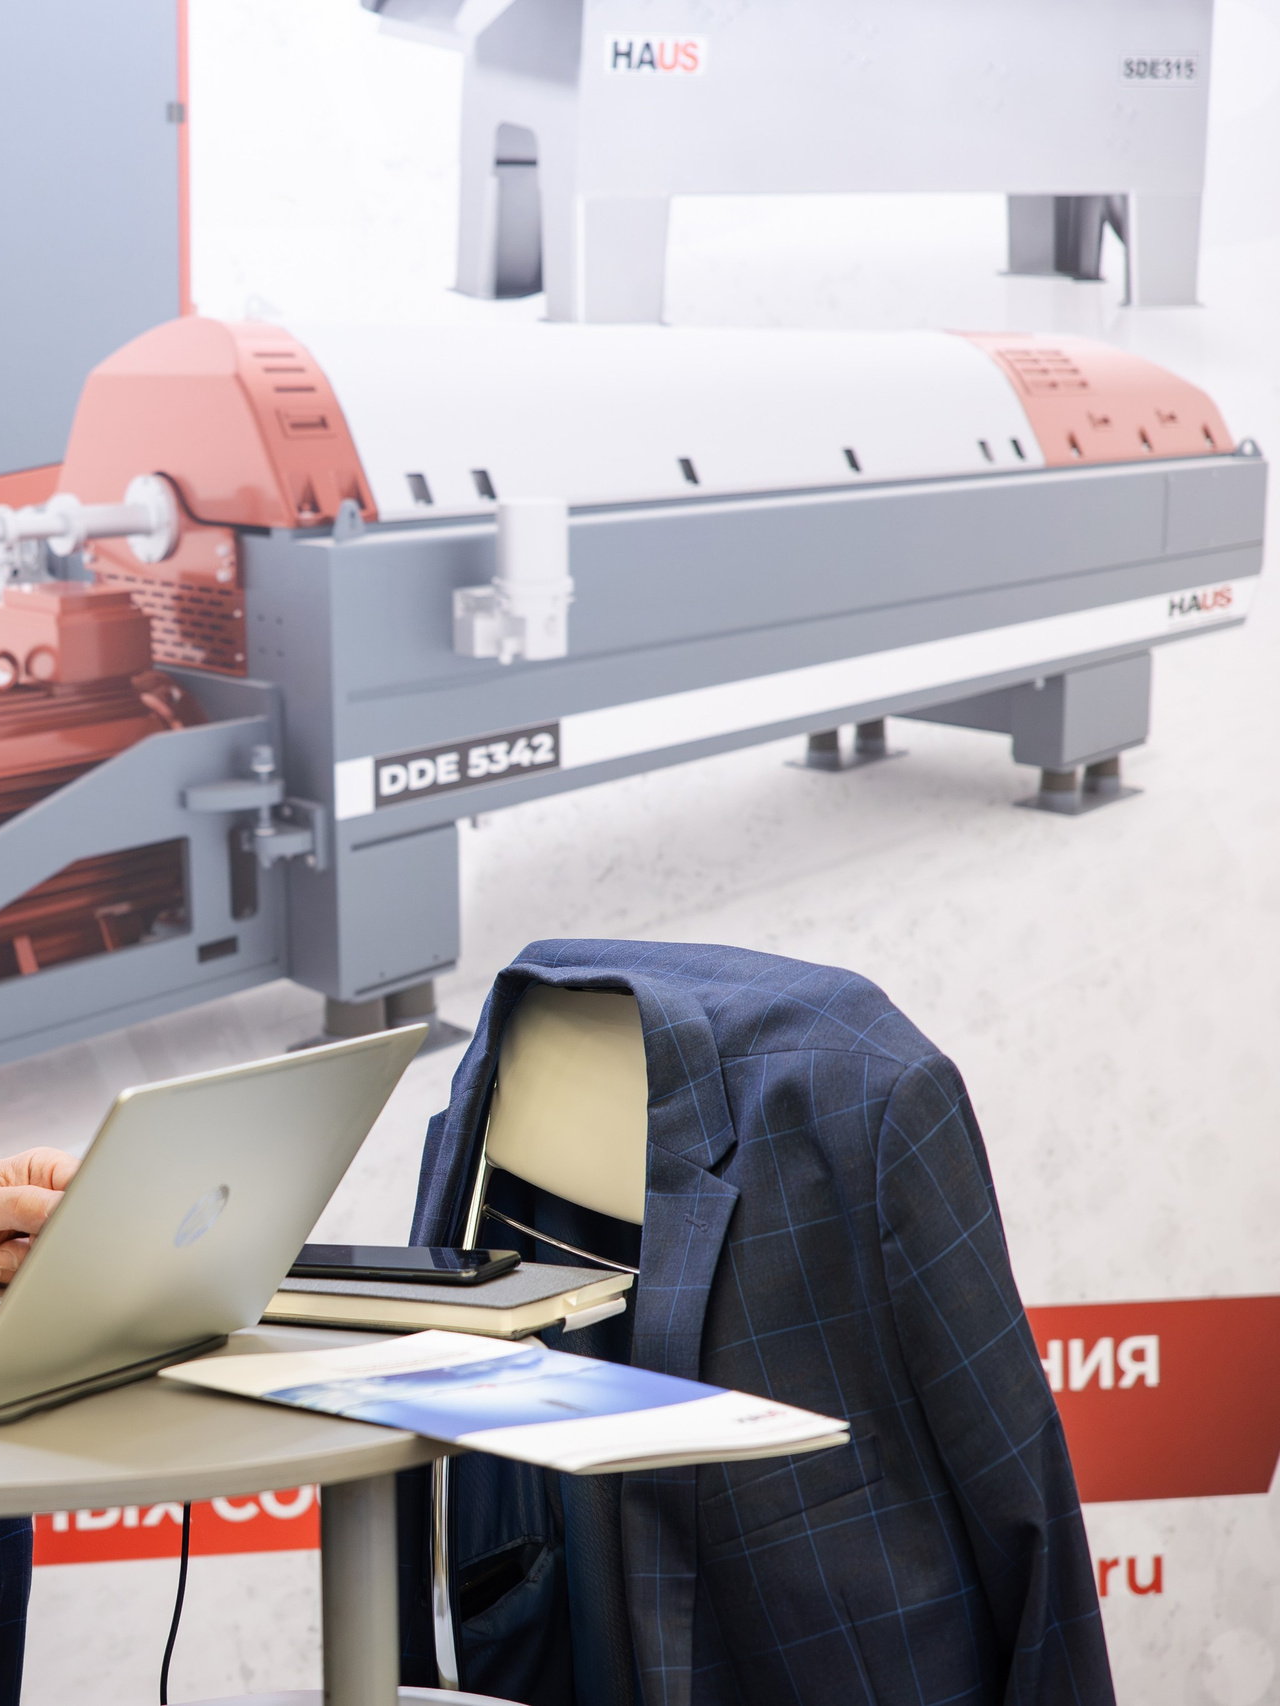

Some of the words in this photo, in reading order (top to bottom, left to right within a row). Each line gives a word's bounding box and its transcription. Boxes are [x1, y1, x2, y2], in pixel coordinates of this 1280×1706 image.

[610, 38, 699, 73] HAUS
[1122, 57, 1197, 79] SDE315
[1168, 586, 1233, 618] HAUS
[378, 752, 461, 797] DDE
[466, 732, 556, 778] 5342
